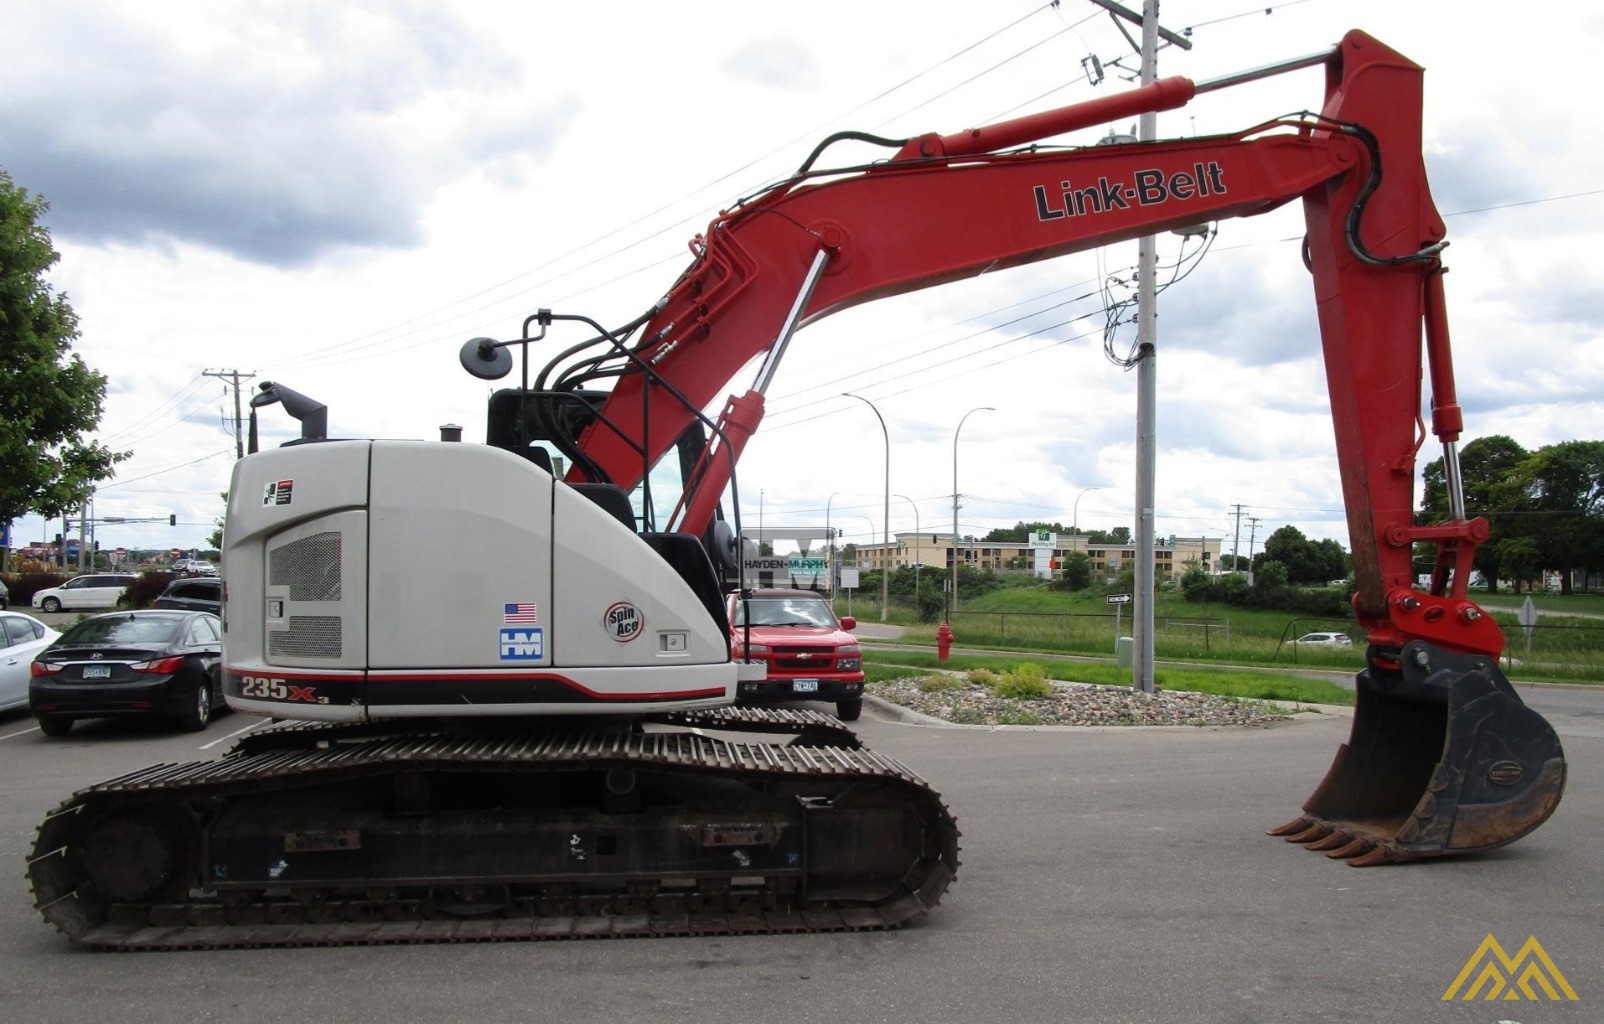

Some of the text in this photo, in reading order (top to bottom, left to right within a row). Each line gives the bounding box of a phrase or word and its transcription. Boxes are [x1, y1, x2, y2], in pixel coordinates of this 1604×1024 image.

[1033, 161, 1227, 221] Link-Belt
[610, 607, 635, 624] Spin
[616, 620, 639, 636] Ace
[501, 632, 541, 656] HM
